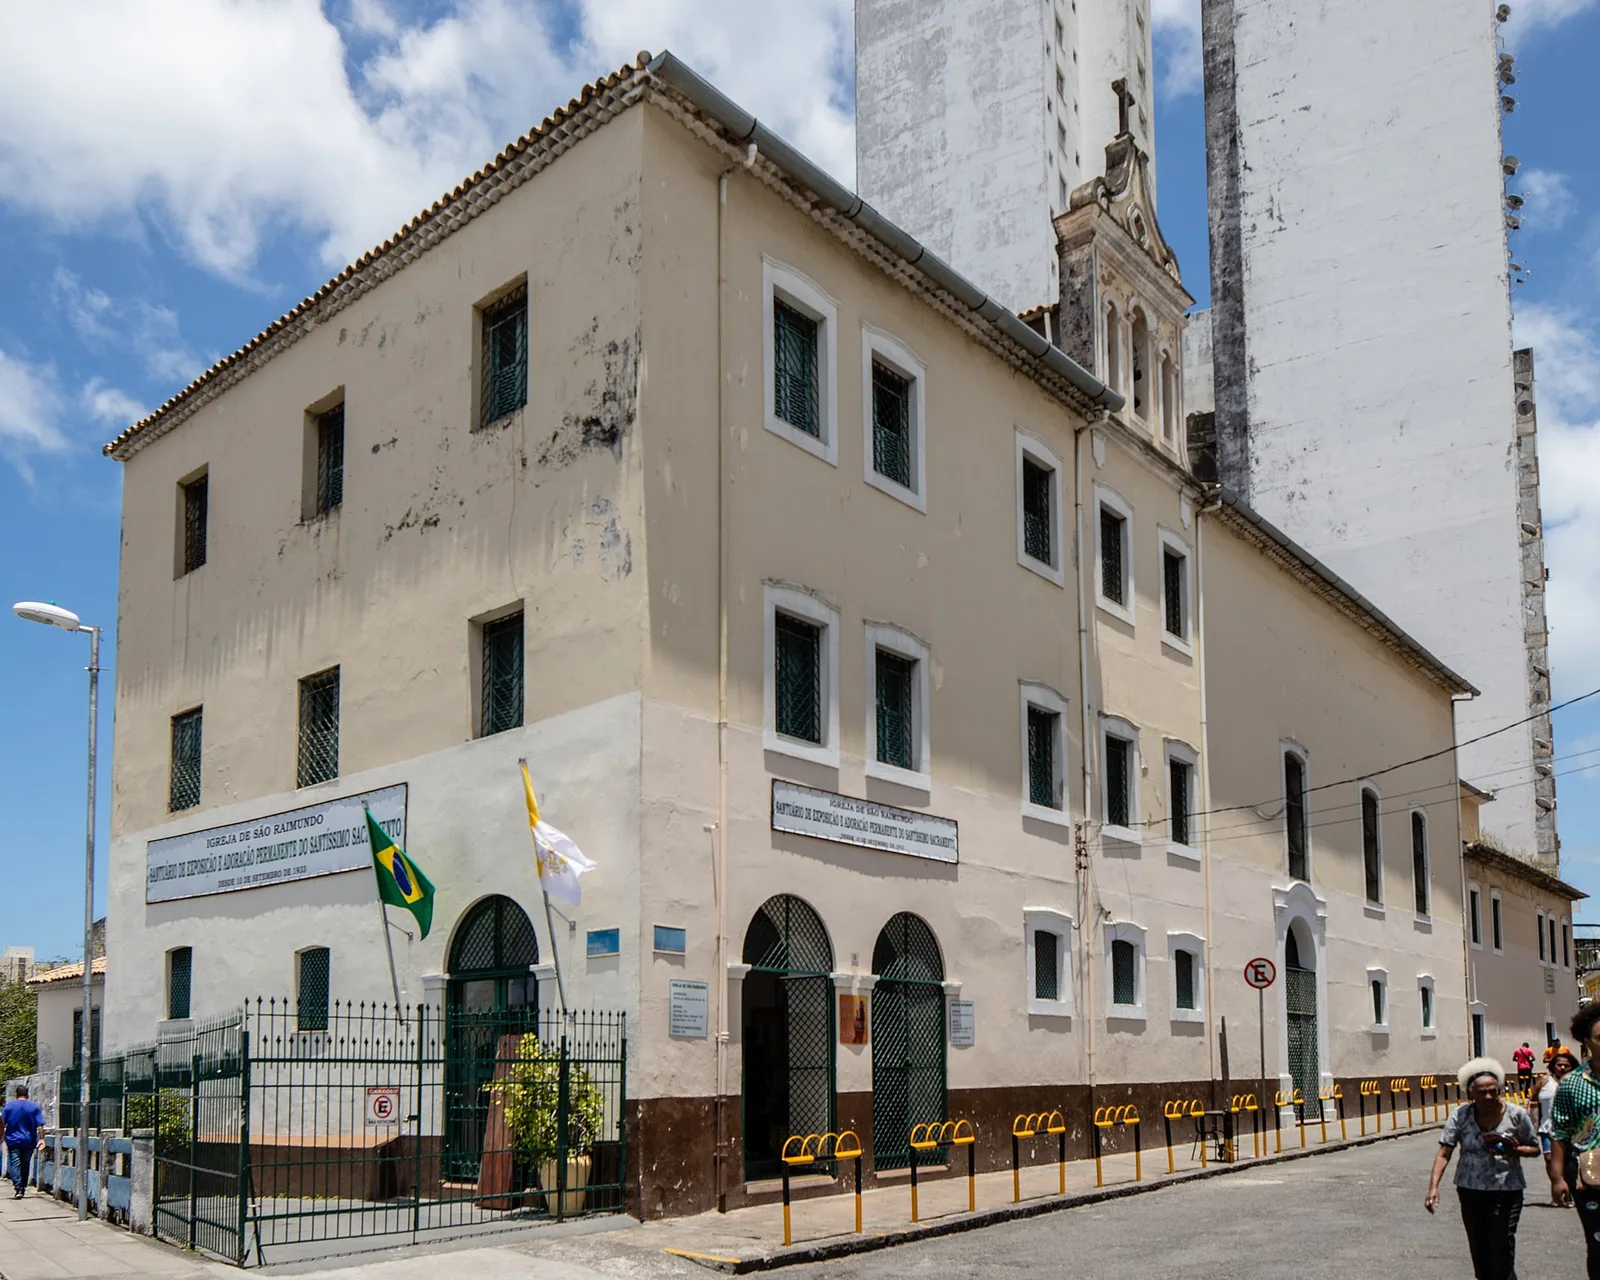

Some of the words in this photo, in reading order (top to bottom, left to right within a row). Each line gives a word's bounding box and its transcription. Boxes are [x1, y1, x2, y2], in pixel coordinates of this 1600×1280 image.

[805, 807, 812, 820] DE
[840, 815, 844, 827] E
[898, 827, 905, 840] DO
[829, 799, 855, 812] IGREJA
[856, 804, 865, 814] DE
[867, 806, 880, 817] SÃO
[881, 810, 914, 824] RAIMUNDO
[206, 833, 237, 849] IGREJA
[239, 831, 251, 842] DE
[253, 825, 271, 839] SÃO
[273, 814, 324, 835] RAIMUNDO
[149, 860, 177, 883] SANTUÁRIO
[178, 862, 186, 878] DE
[187, 853, 217, 878] EXPOSIÇÃO
[218, 855, 222, 872] E
[223, 845, 255, 872] ADORAÇÃO
[256, 840, 297, 865] PERMANENTE
[299, 838, 308, 857] DO
[309, 828, 351, 854] SANTÍSSIMO
[217, 878, 235, 888] DESDE
[243, 876, 251, 884] DE
[252, 869, 283, 882] SETEMBRO
[283, 867, 292, 877] DE
